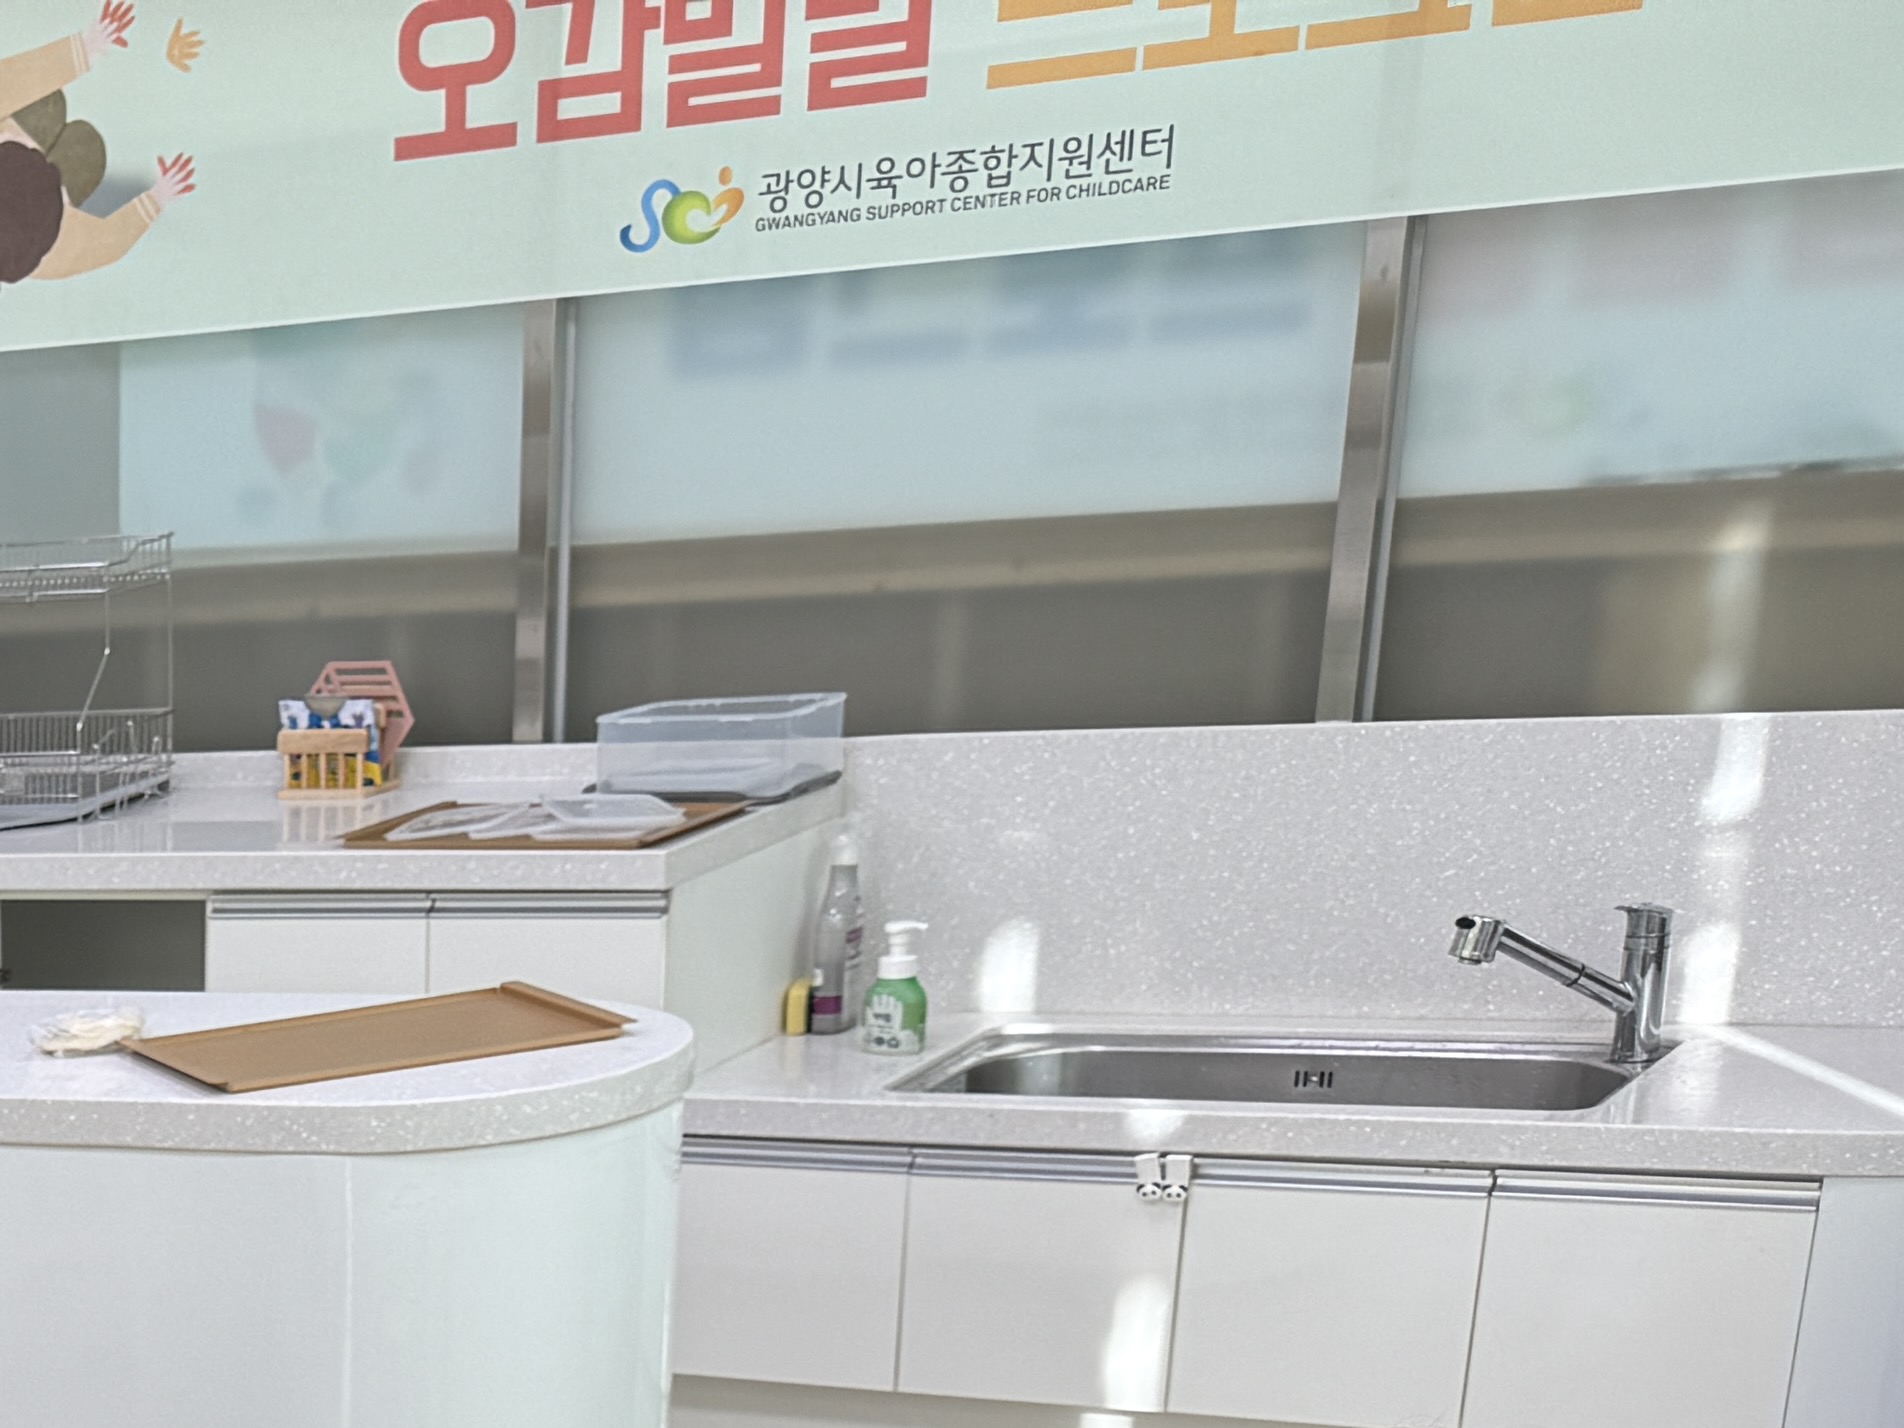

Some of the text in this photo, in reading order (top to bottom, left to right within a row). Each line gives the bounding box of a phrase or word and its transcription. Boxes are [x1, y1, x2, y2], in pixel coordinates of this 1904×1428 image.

[755, 174, 1171, 232] GWANGYANG SUPPORT CENTER FOR CHILDCARE
[757, 123, 1175, 214] 광양시육아종합지원센터
